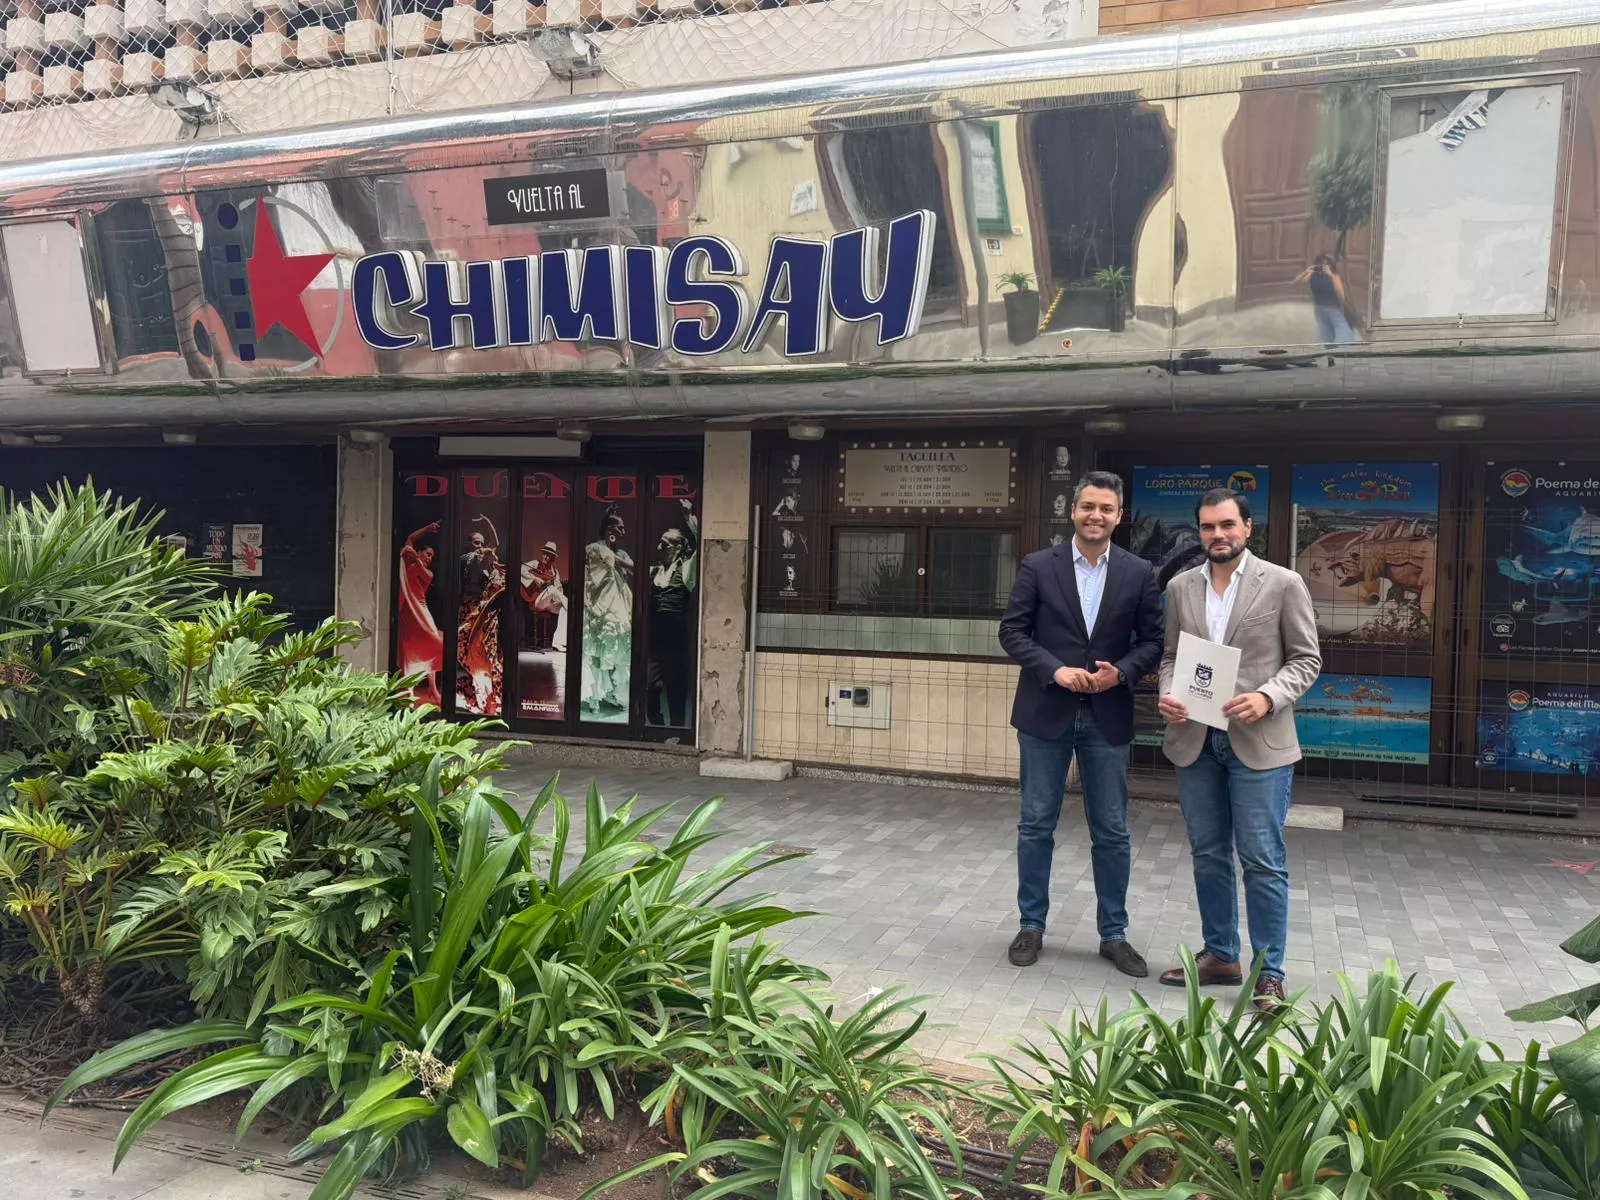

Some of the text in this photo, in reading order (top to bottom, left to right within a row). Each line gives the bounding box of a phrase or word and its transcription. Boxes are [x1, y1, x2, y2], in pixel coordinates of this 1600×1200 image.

[507, 184, 585, 213] VUELTA AL
[350, 208, 936, 357] CHIMISAY
[899, 451, 956, 462] TAQUILLA
[404, 472, 697, 502] DUENDE
[1145, 479, 1223, 489] LORO PARQUE
[1535, 477, 1600, 489] Poema de
[208, 530, 226, 538] TODO
[1189, 685, 1214, 696] PUERTO
[1532, 697, 1565, 708] Poema
[1566, 699, 1582, 709] del
